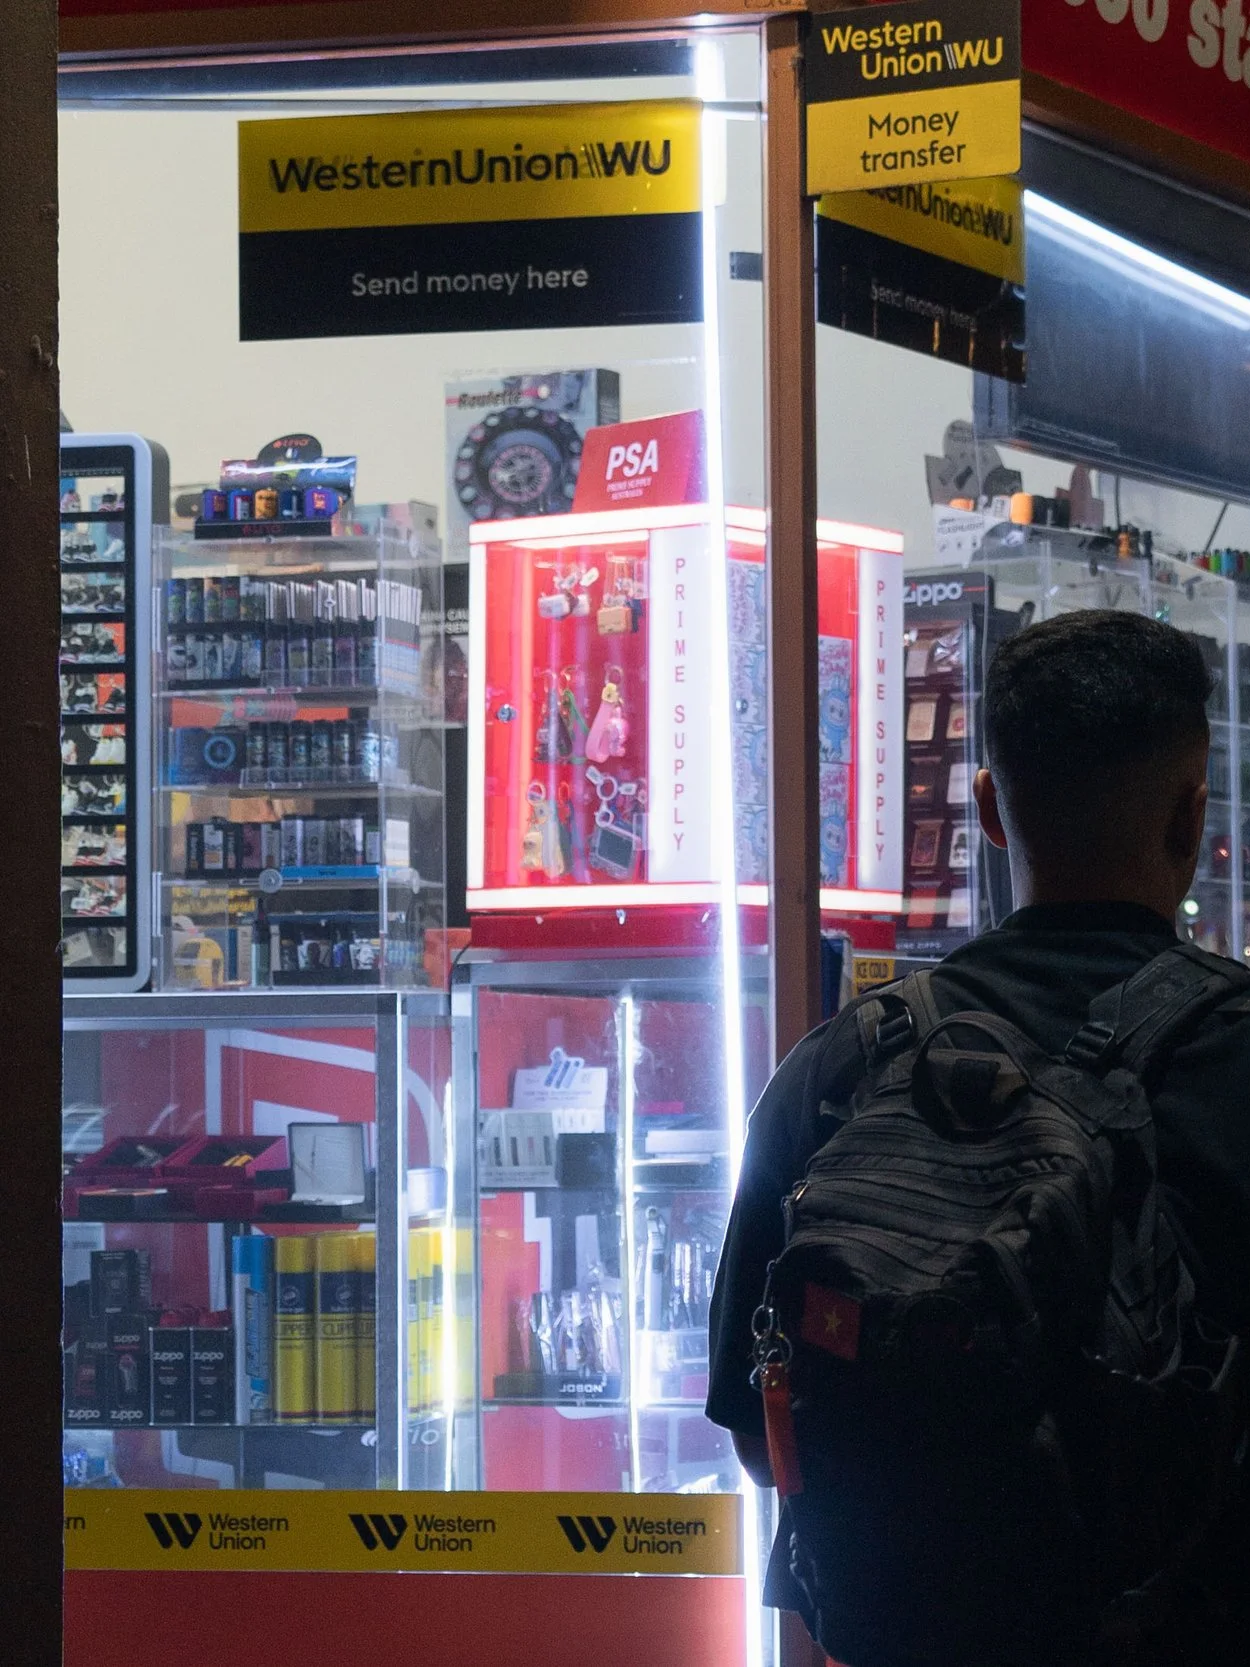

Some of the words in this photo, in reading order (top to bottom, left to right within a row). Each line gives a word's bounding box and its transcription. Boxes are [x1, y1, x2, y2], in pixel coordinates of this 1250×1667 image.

[822, 20, 942, 54] Western
[861, 48, 942, 80] Union
[952, 37, 1003, 69] WU
[868, 111, 959, 139] Money
[861, 140, 966, 173] transfer
[352, 271, 418, 297] Send
[427, 269, 520, 296] money
[527, 266, 589, 289] here
[606, 439, 658, 481] PSA
[674, 557, 686, 683] PRIME
[876, 580, 885, 700] PRIME
[673, 704, 685, 851] SUPPLY
[875, 721, 885, 861] SUPPLY
[209, 1513, 289, 1531] Western
[414, 1515, 495, 1533] Western
[623, 1517, 706, 1535] Western
[209, 1532, 266, 1550] Union
[414, 1534, 472, 1552] Union
[623, 1536, 682, 1554] Union
